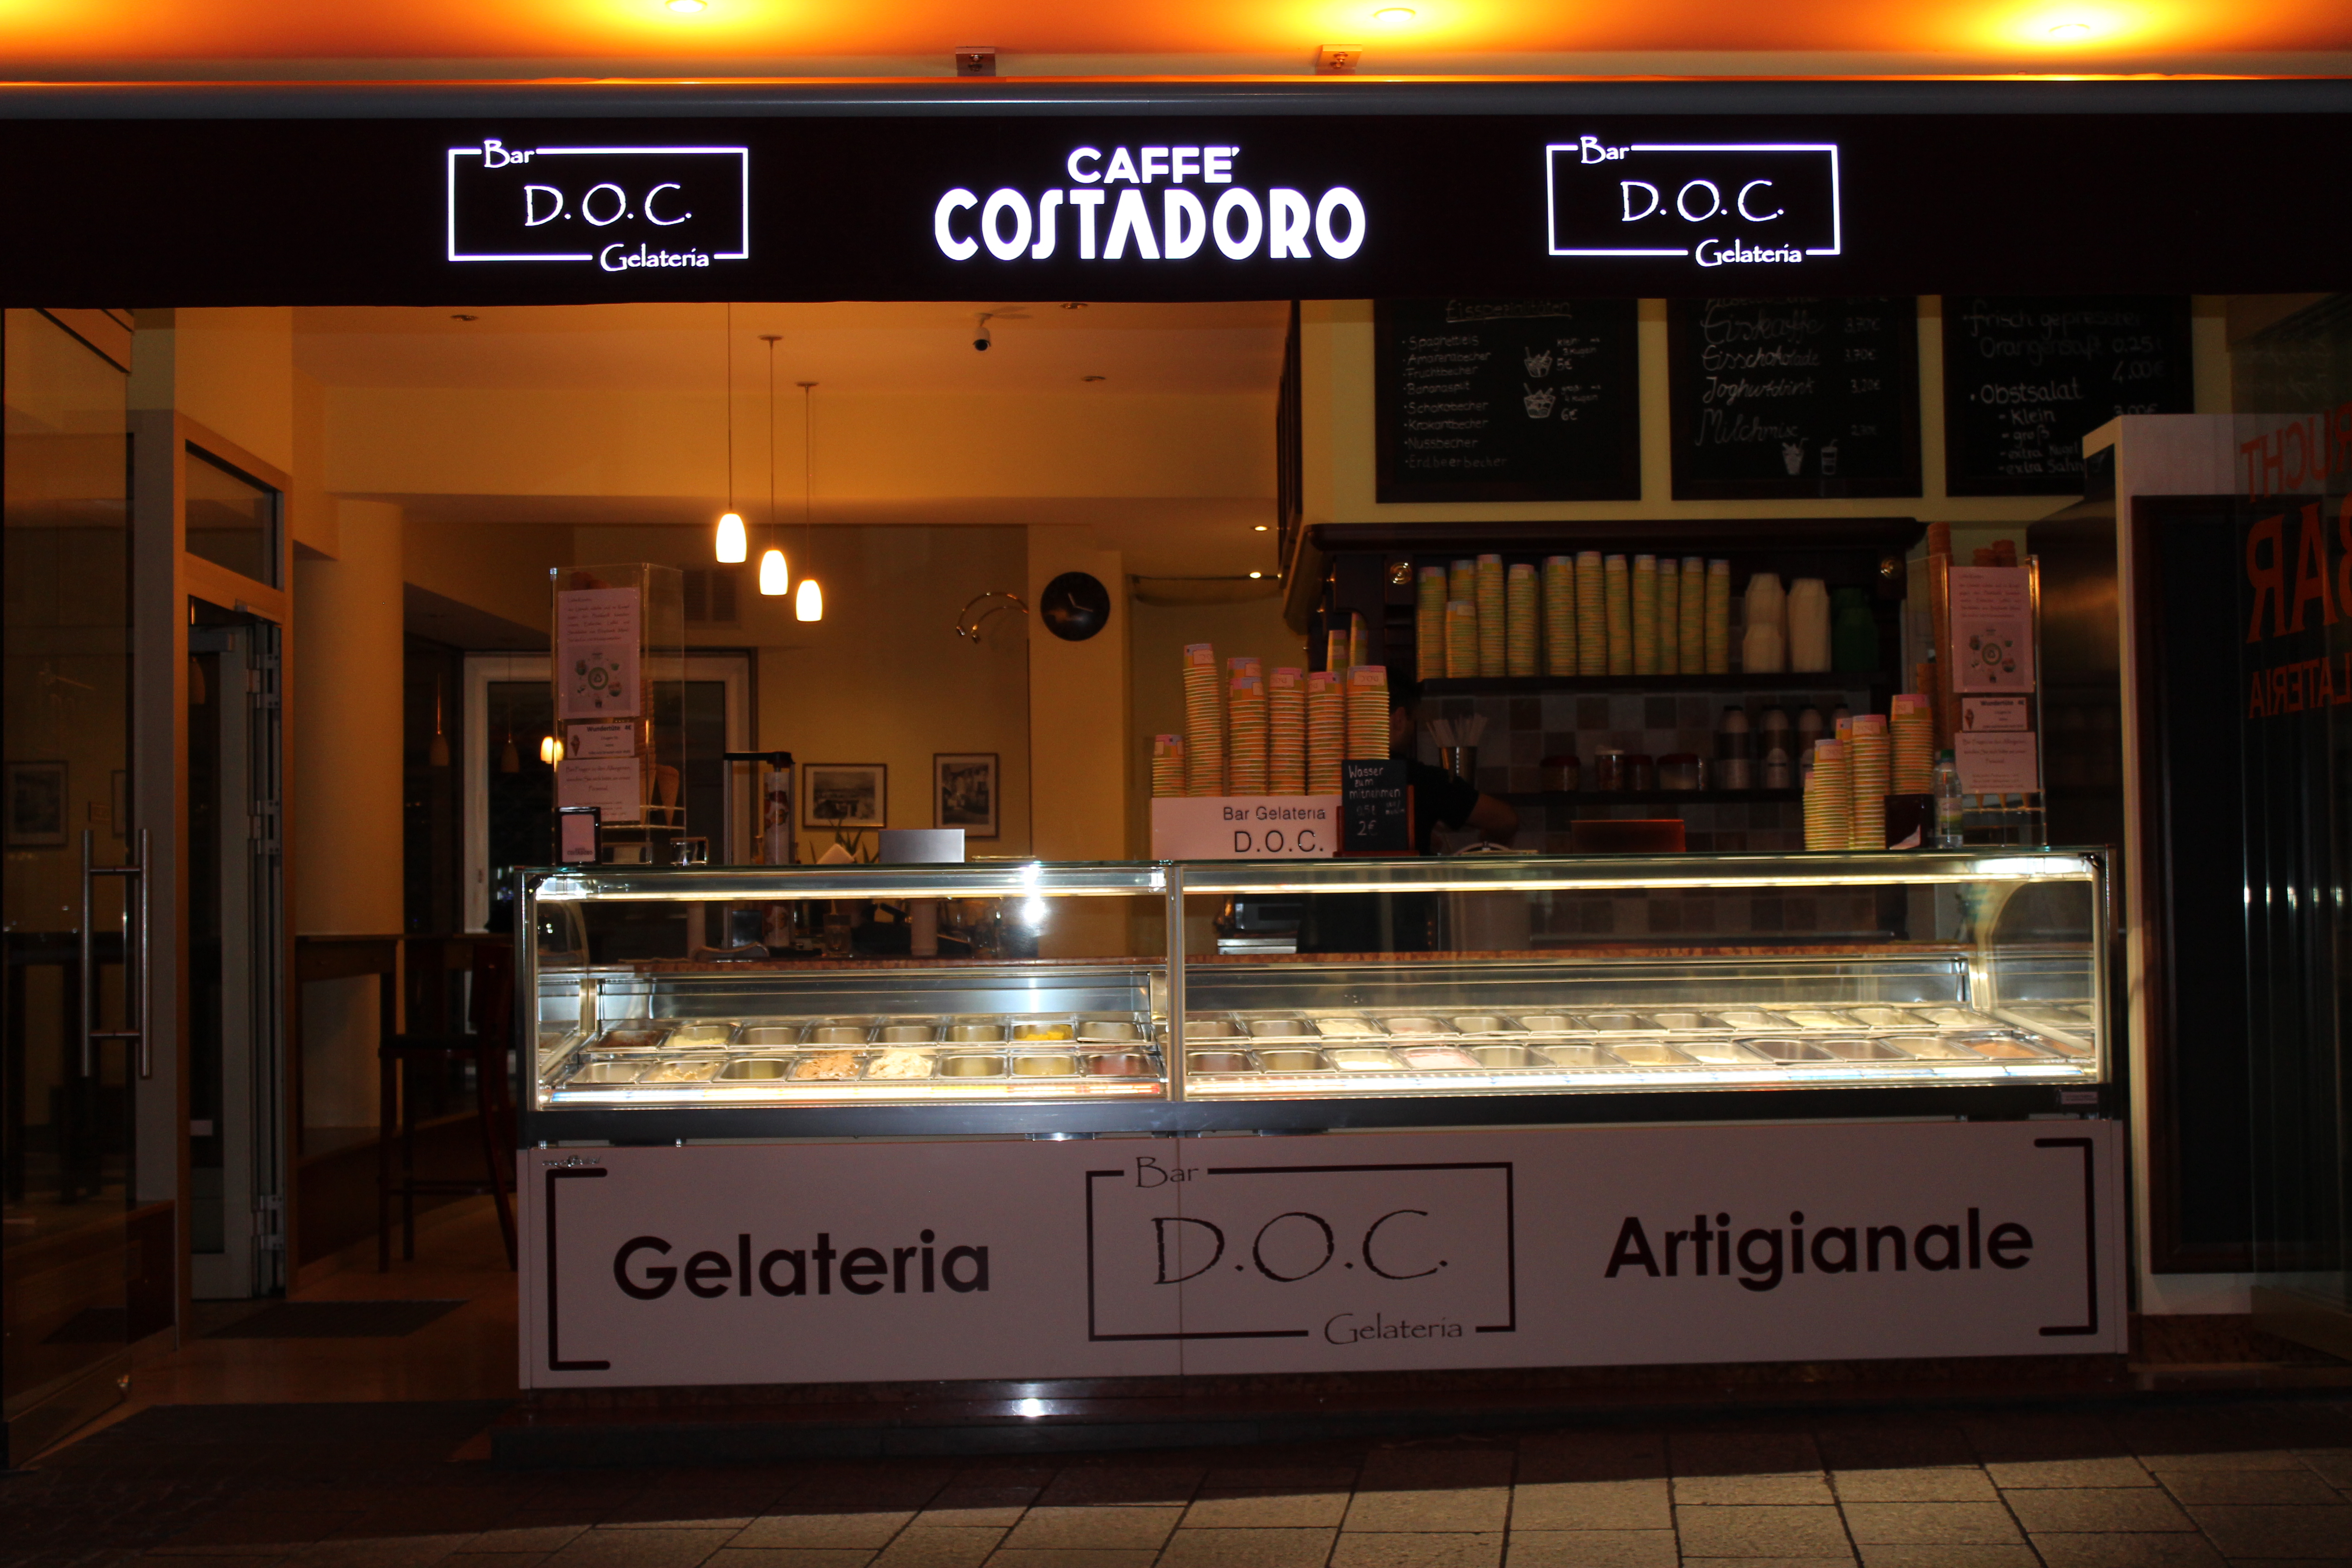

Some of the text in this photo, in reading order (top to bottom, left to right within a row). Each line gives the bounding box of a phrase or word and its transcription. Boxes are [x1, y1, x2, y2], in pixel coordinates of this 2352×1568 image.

[484, 139, 535, 168] Bar
[1580, 136, 1630, 164] Bar
[524, 183, 692, 226] D.O.C.
[1620, 180, 1784, 222] D.O.C.
[934, 186, 1366, 261] COSTADORO
[600, 243, 710, 272] Gelateria
[1695, 238, 1802, 267] Gelateria
[1557, 357, 1573, 371] 5€
[1980, 377, 2084, 404] Obstsalat
[1560, 407, 1578, 421] 6€
[1348, 764, 1383, 779] Wasser
[1355, 779, 1373, 788] zum
[1349, 789, 1401, 799] mitnehmen
[1224, 806, 1326, 820] Bar Gelateria
[1357, 819, 1378, 836] 2€
[1235, 830, 1323, 853] D.O.C.
[1136, 1156, 1199, 1188] Bar
[1151, 1210, 1448, 1285] D.O.C.
[1604, 1207, 2033, 1291] Artigianale
[613, 1229, 990, 1300] Gelateria
[1324, 1313, 1462, 1345] Gelateria
